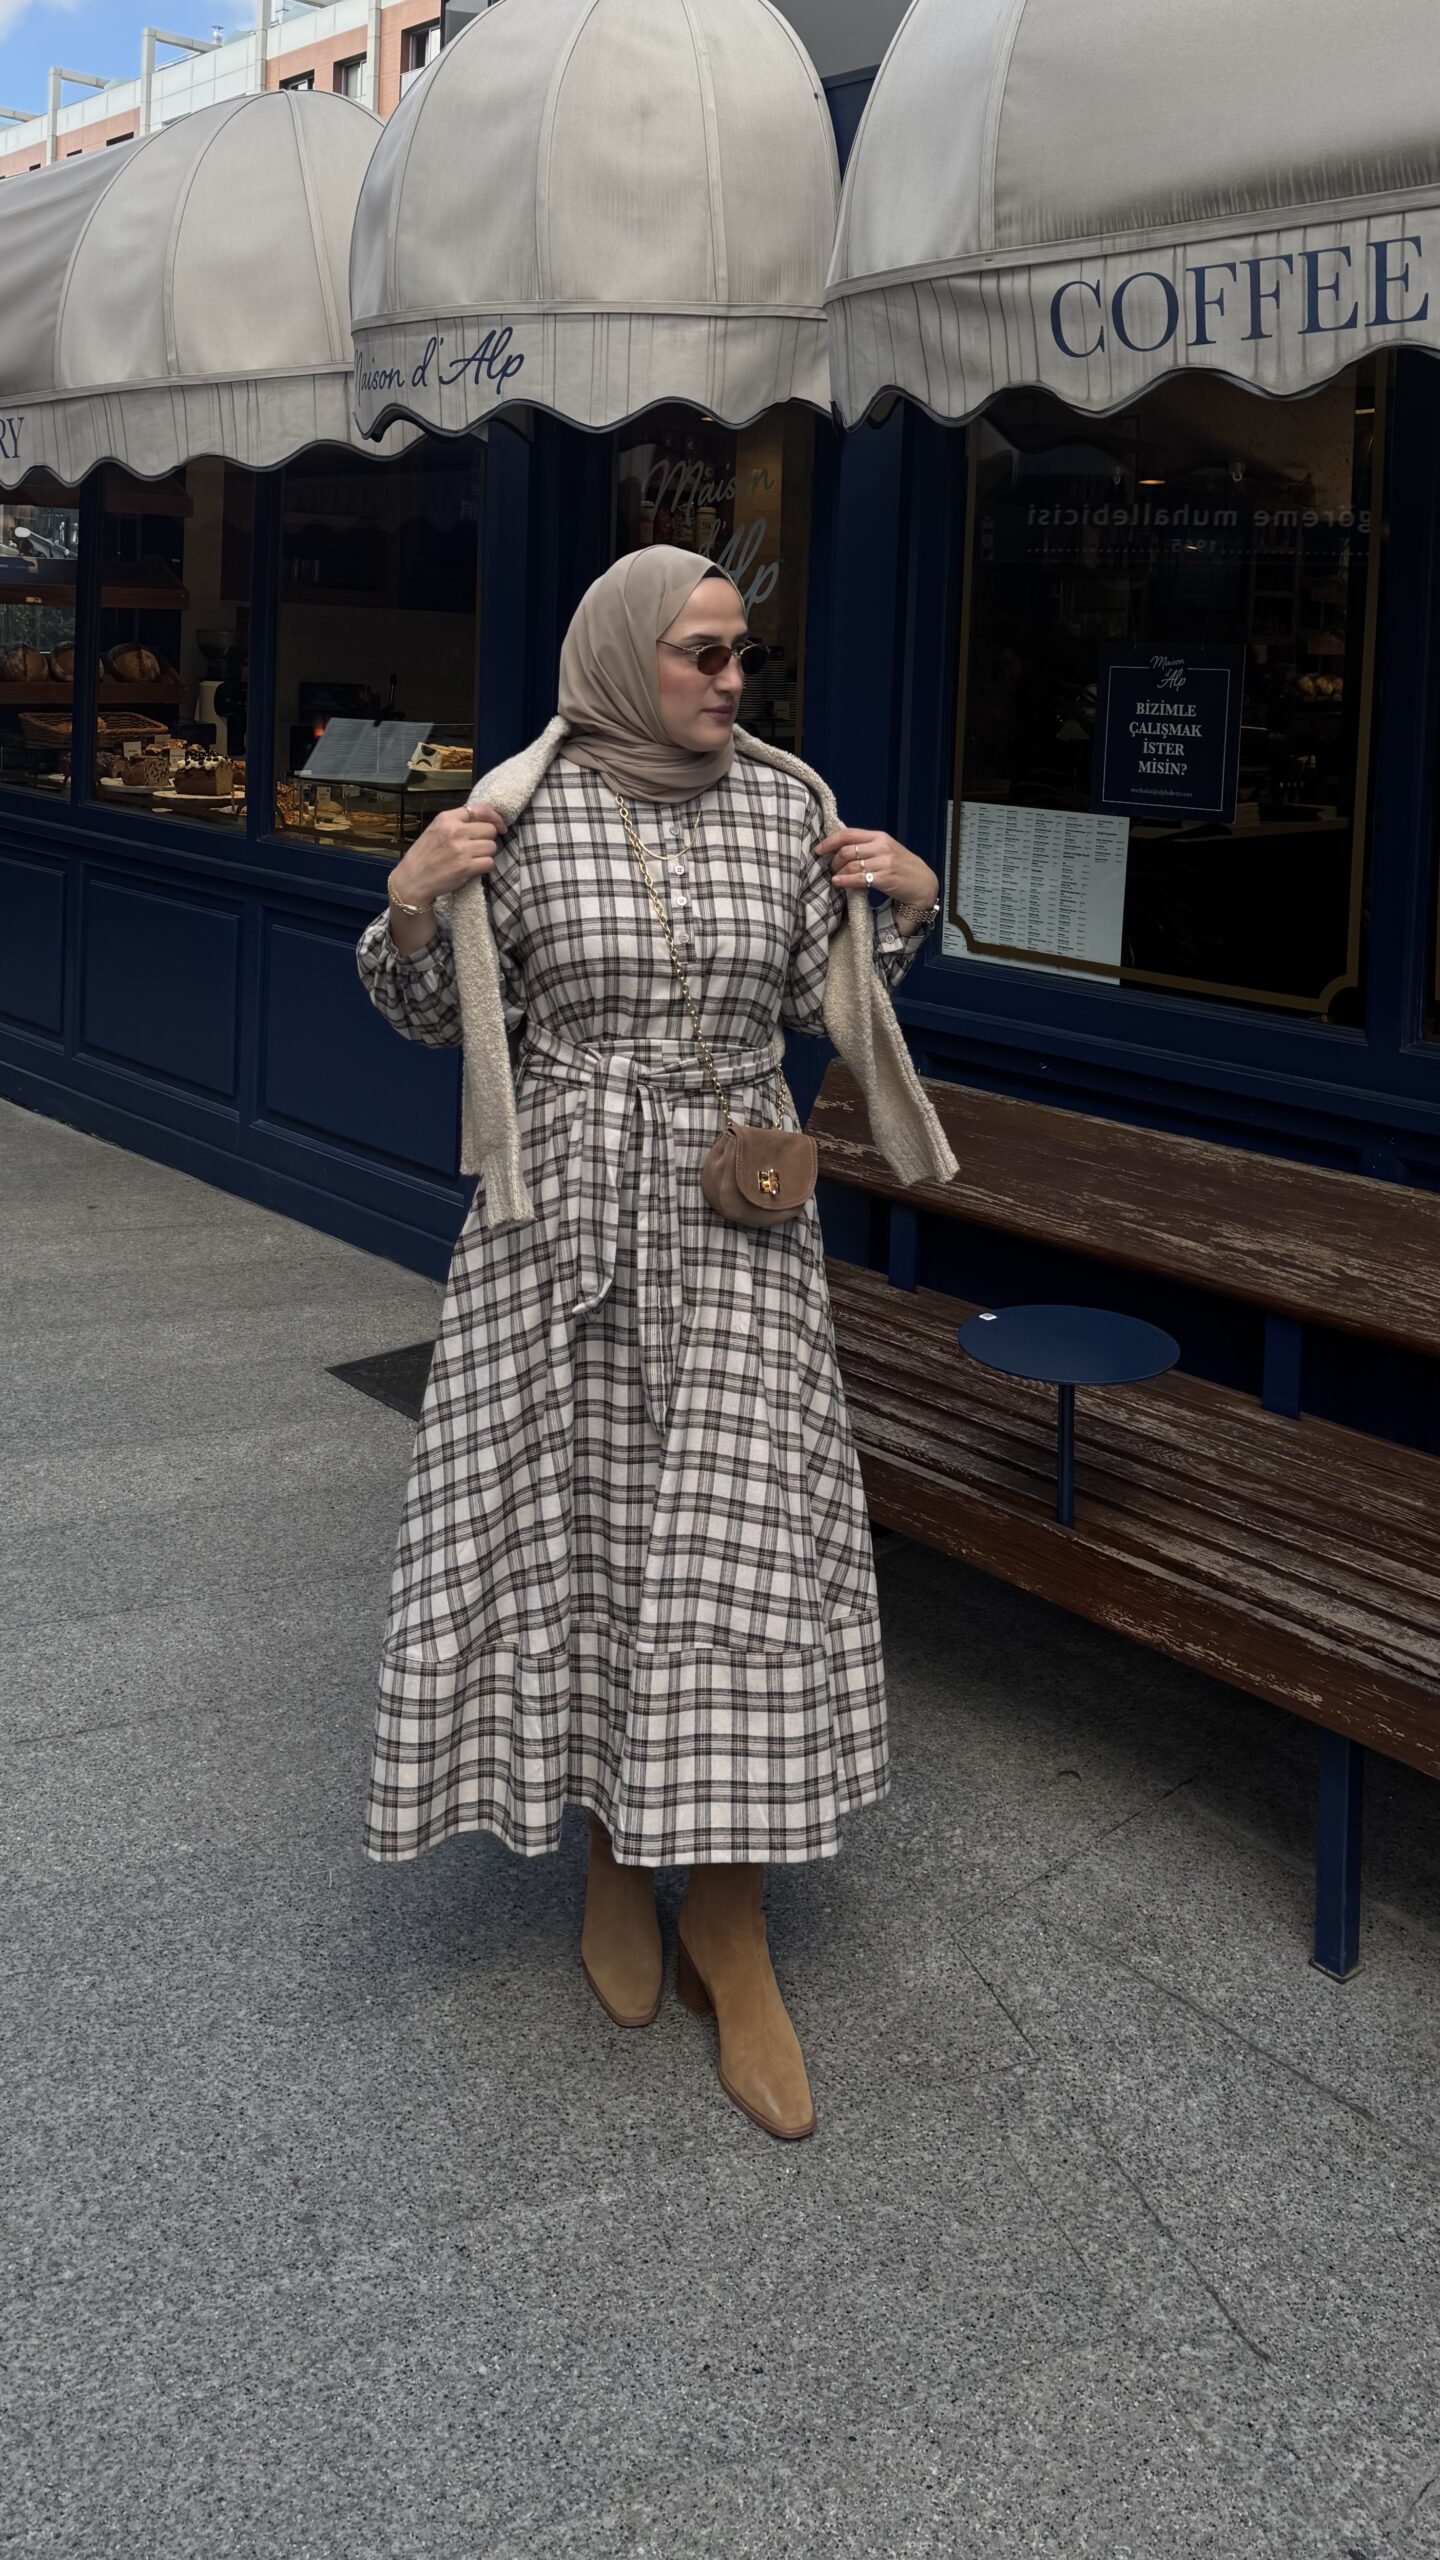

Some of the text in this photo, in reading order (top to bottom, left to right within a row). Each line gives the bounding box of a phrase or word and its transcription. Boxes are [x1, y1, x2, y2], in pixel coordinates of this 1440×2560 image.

[1050, 235, 1429, 358] COFFEE
[1150, 655, 1185, 671] Maison
[1136, 699, 1196, 717] BİZİMLE
[1129, 722, 1202, 738] ÇALIŞMAK
[1142, 738, 1184, 756] İSTER
[1138, 758, 1187, 775] MİSİN?
